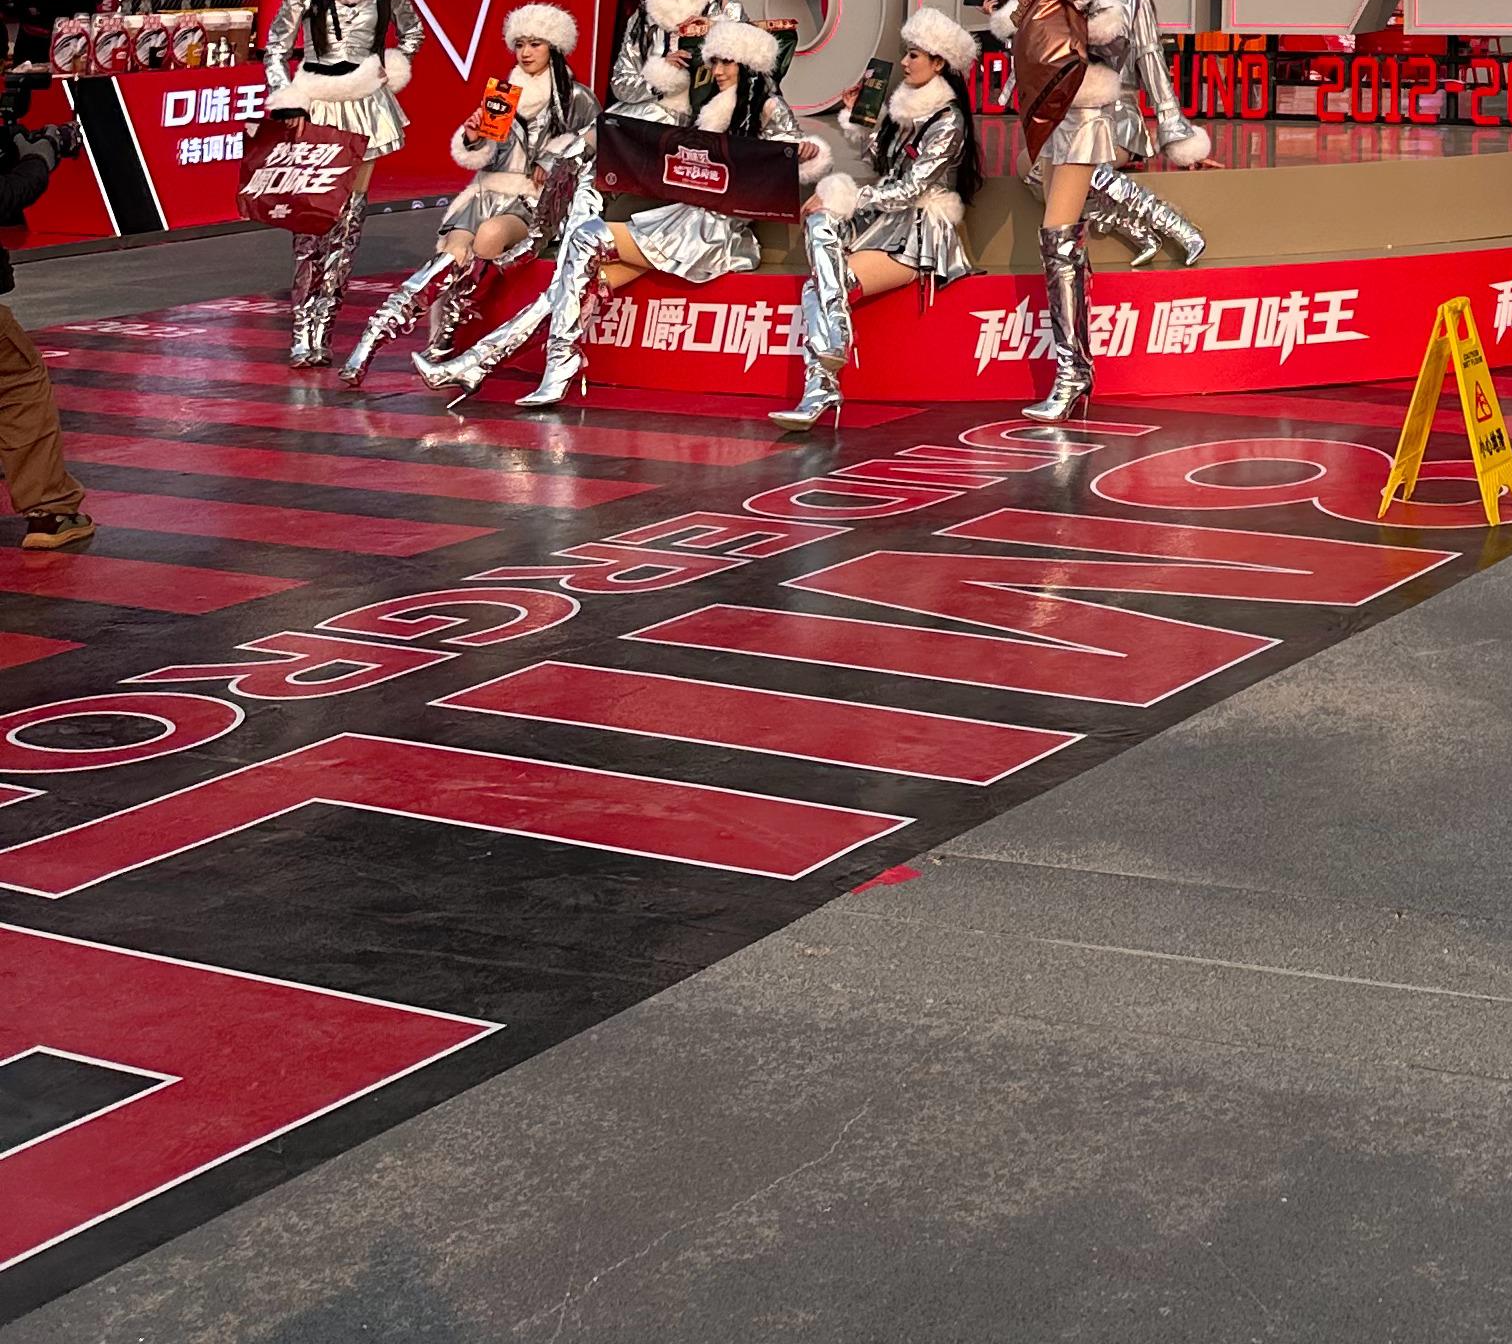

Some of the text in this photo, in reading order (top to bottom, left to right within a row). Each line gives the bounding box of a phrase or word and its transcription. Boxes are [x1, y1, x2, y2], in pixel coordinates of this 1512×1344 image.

[162, 84, 266, 127] 口味王
[265, 141, 344, 168] 秒来劲
[240, 165, 352, 199] 嚼口味王
[641, 297, 808, 373] 嚼口味王
[1146, 288, 1370, 366] 嚼口味王
